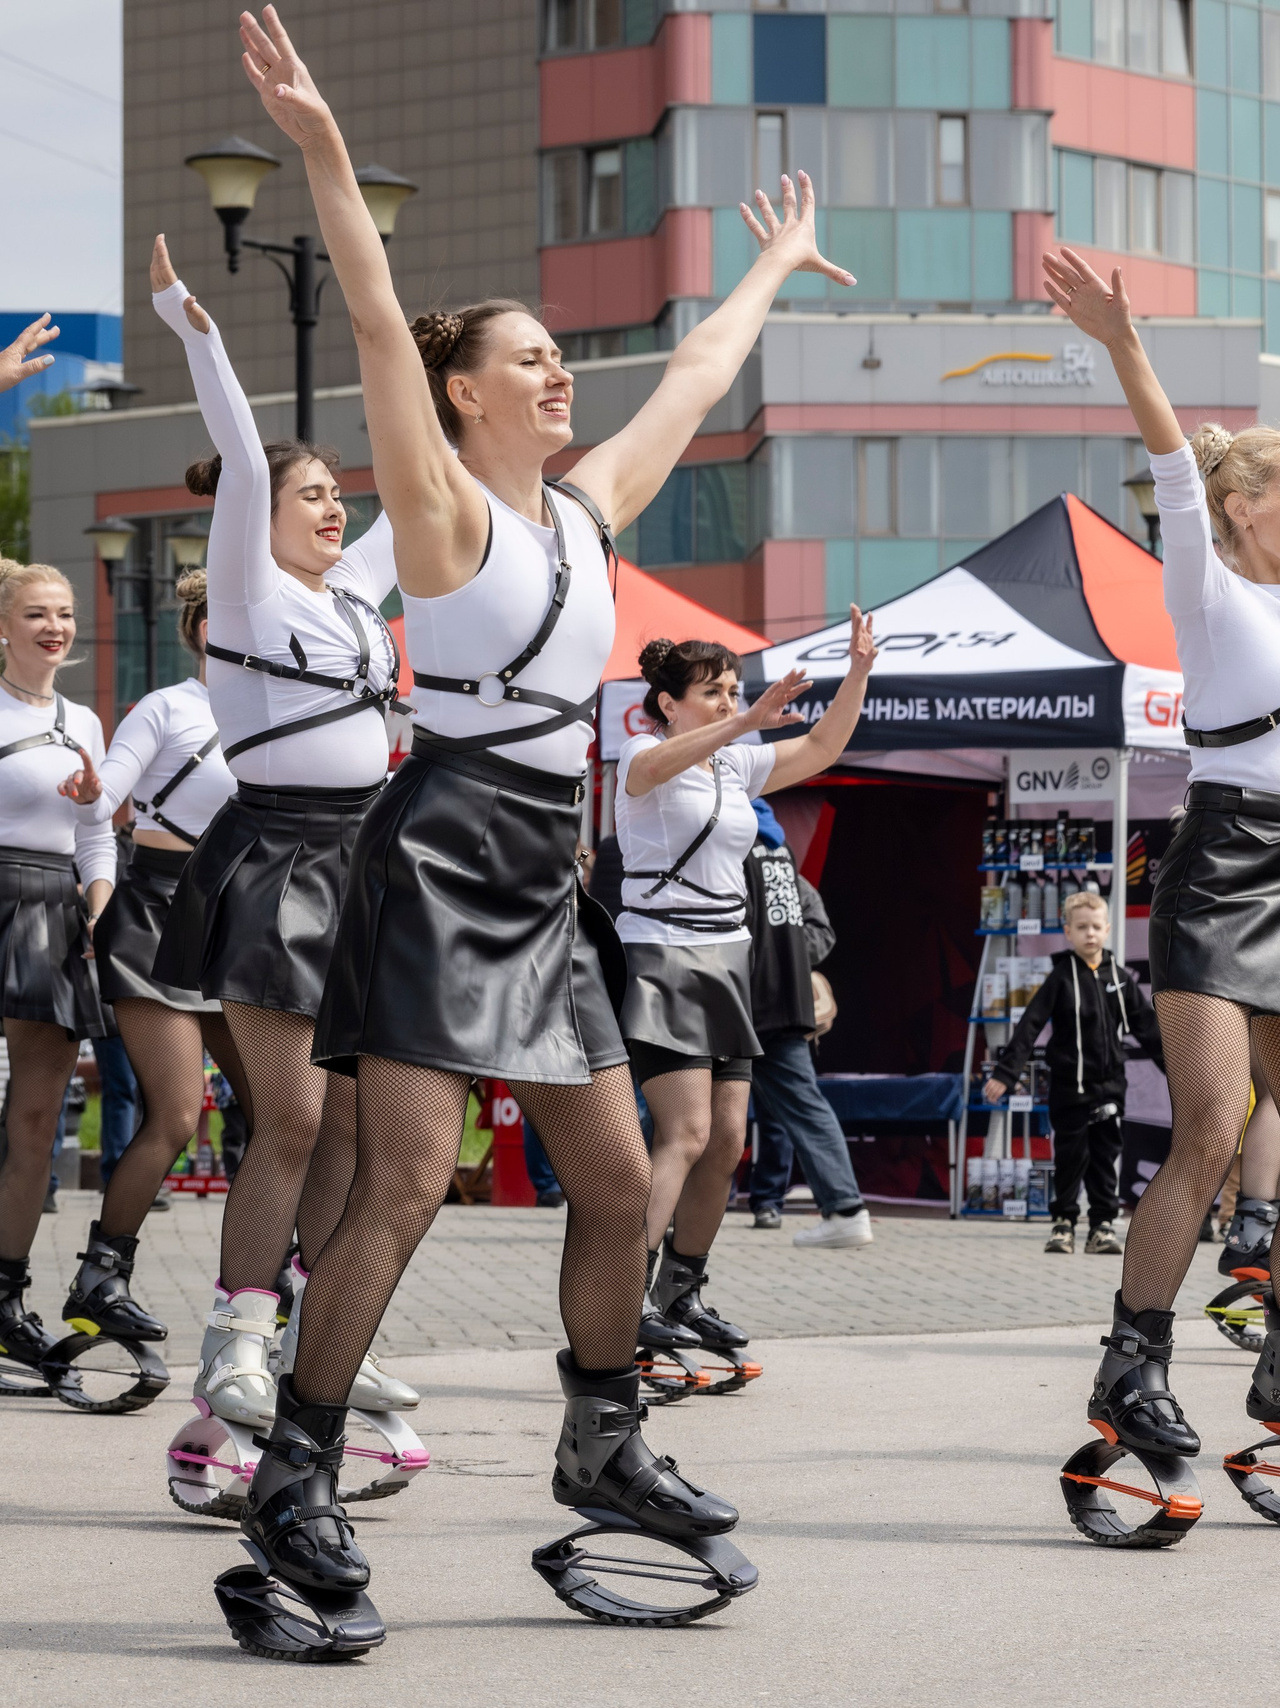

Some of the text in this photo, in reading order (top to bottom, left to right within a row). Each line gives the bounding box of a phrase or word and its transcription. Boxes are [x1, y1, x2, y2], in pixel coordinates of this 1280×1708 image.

[1061, 343, 1096, 371] 54
[935, 694, 1096, 721] МАТЕРИАЛЫ
[1017, 769, 1065, 792] GNV
